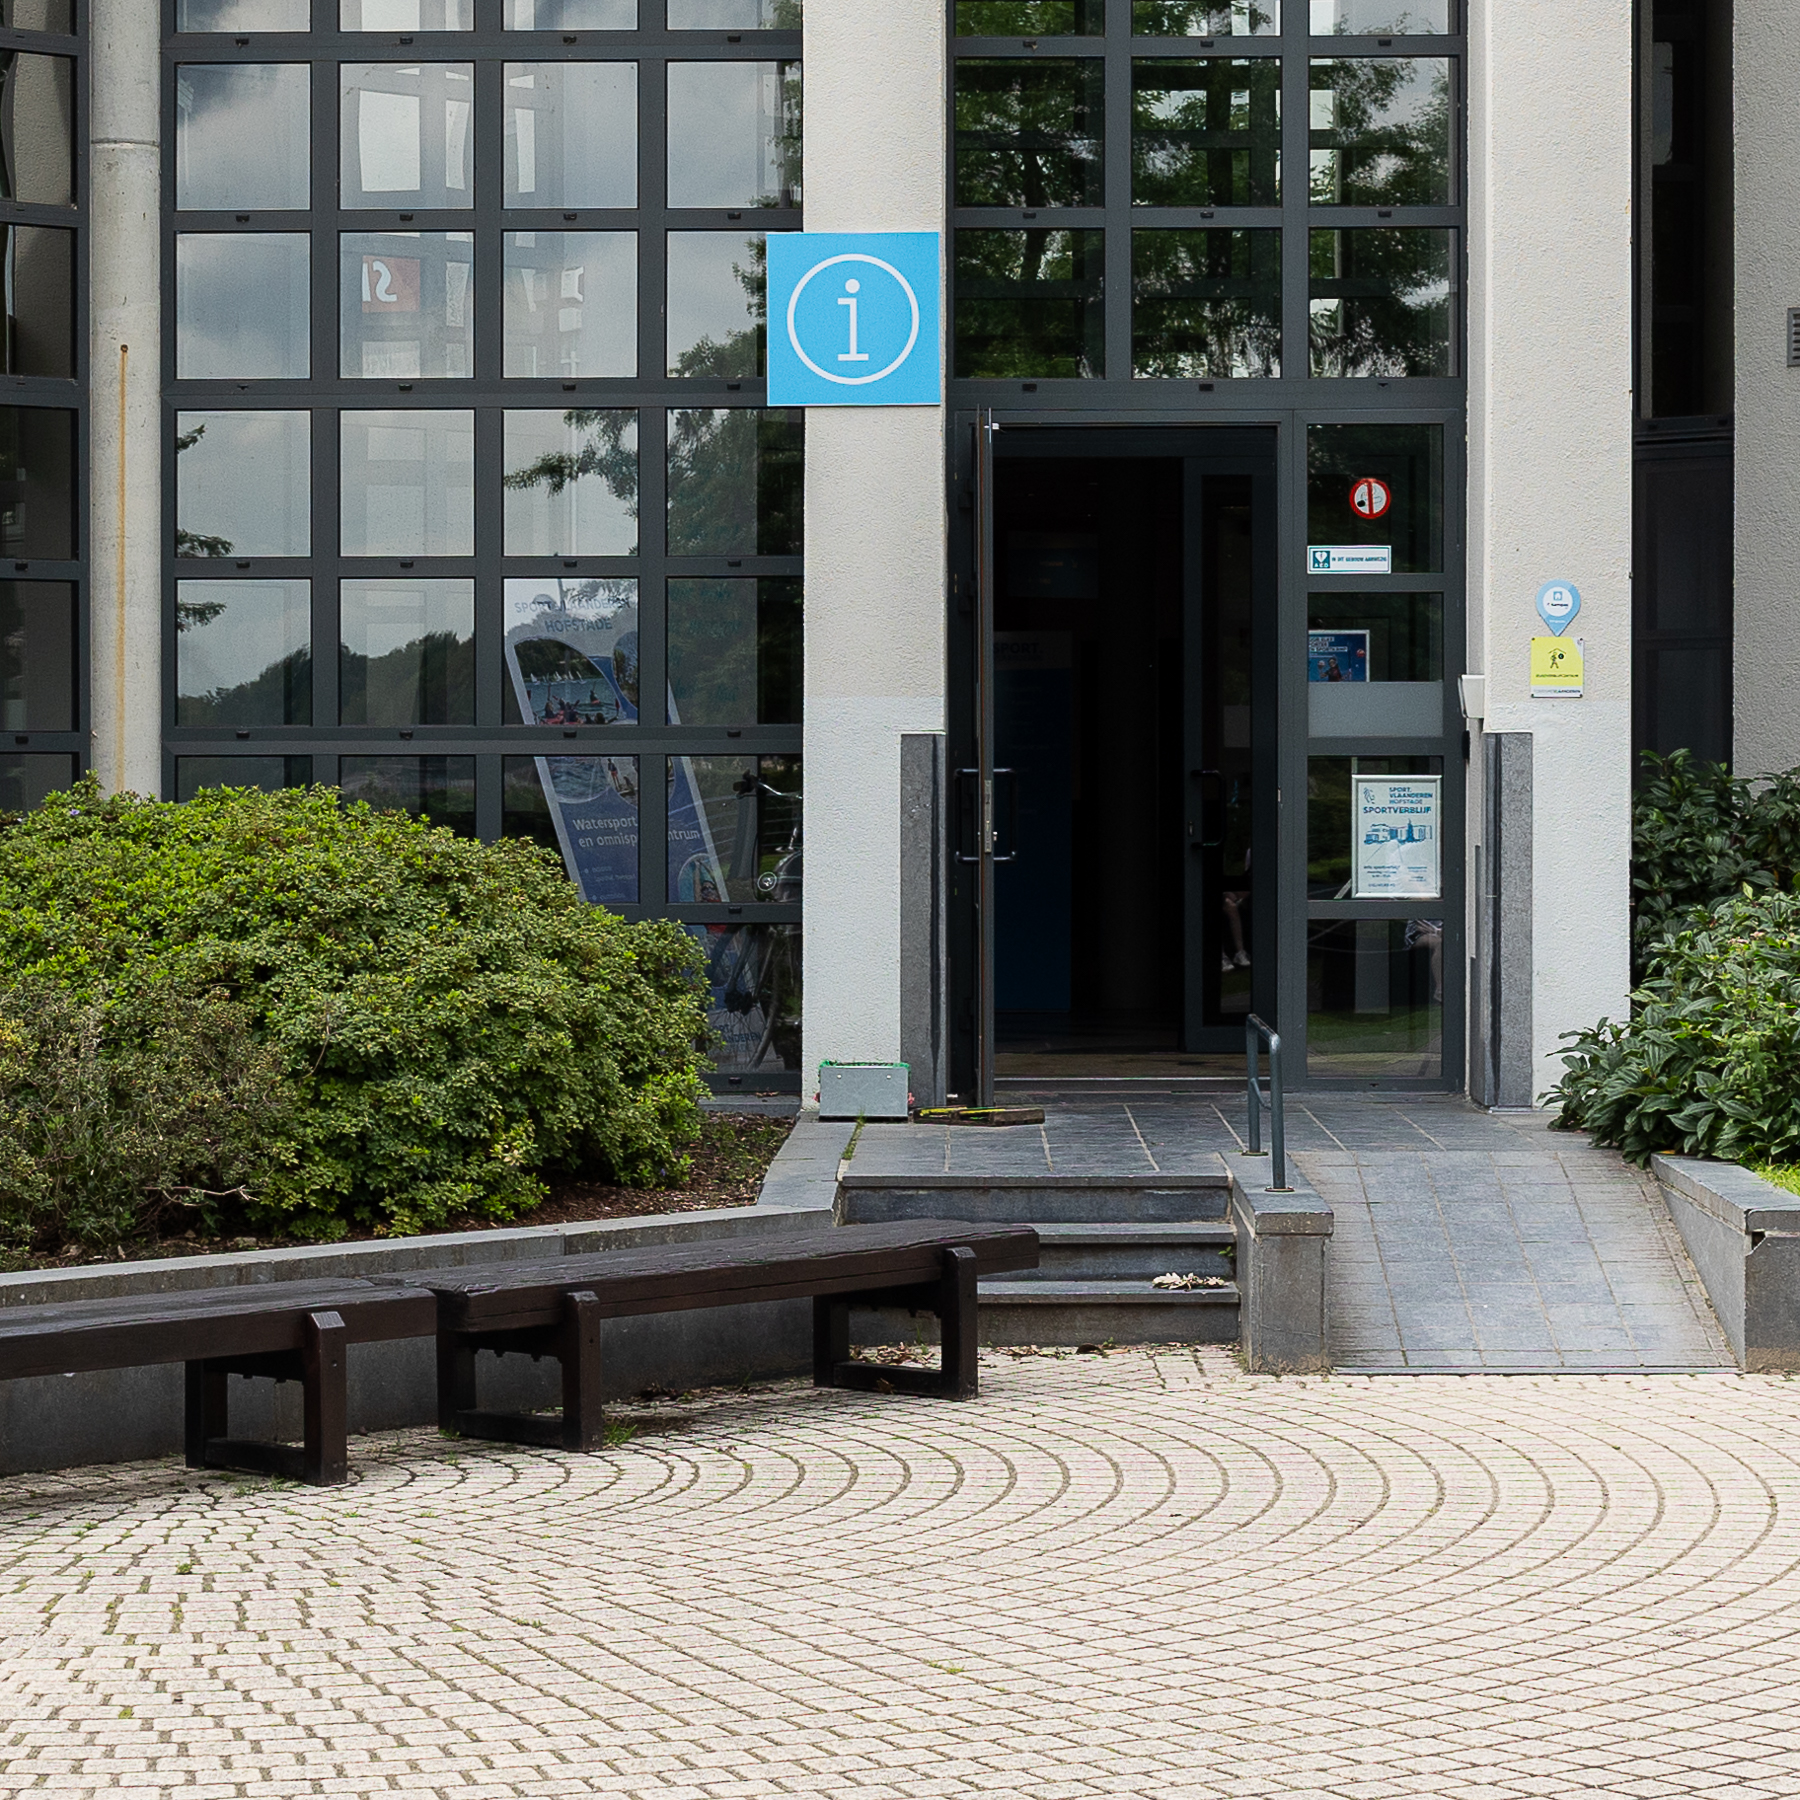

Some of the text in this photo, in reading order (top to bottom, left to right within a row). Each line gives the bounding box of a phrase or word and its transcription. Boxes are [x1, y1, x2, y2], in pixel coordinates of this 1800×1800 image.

[544, 617, 613, 632] HOFSTADE
[1363, 806, 1431, 814] SPORTVERBLIJF
[572, 816, 638, 832] Watersport
[578, 837, 594, 848] en
